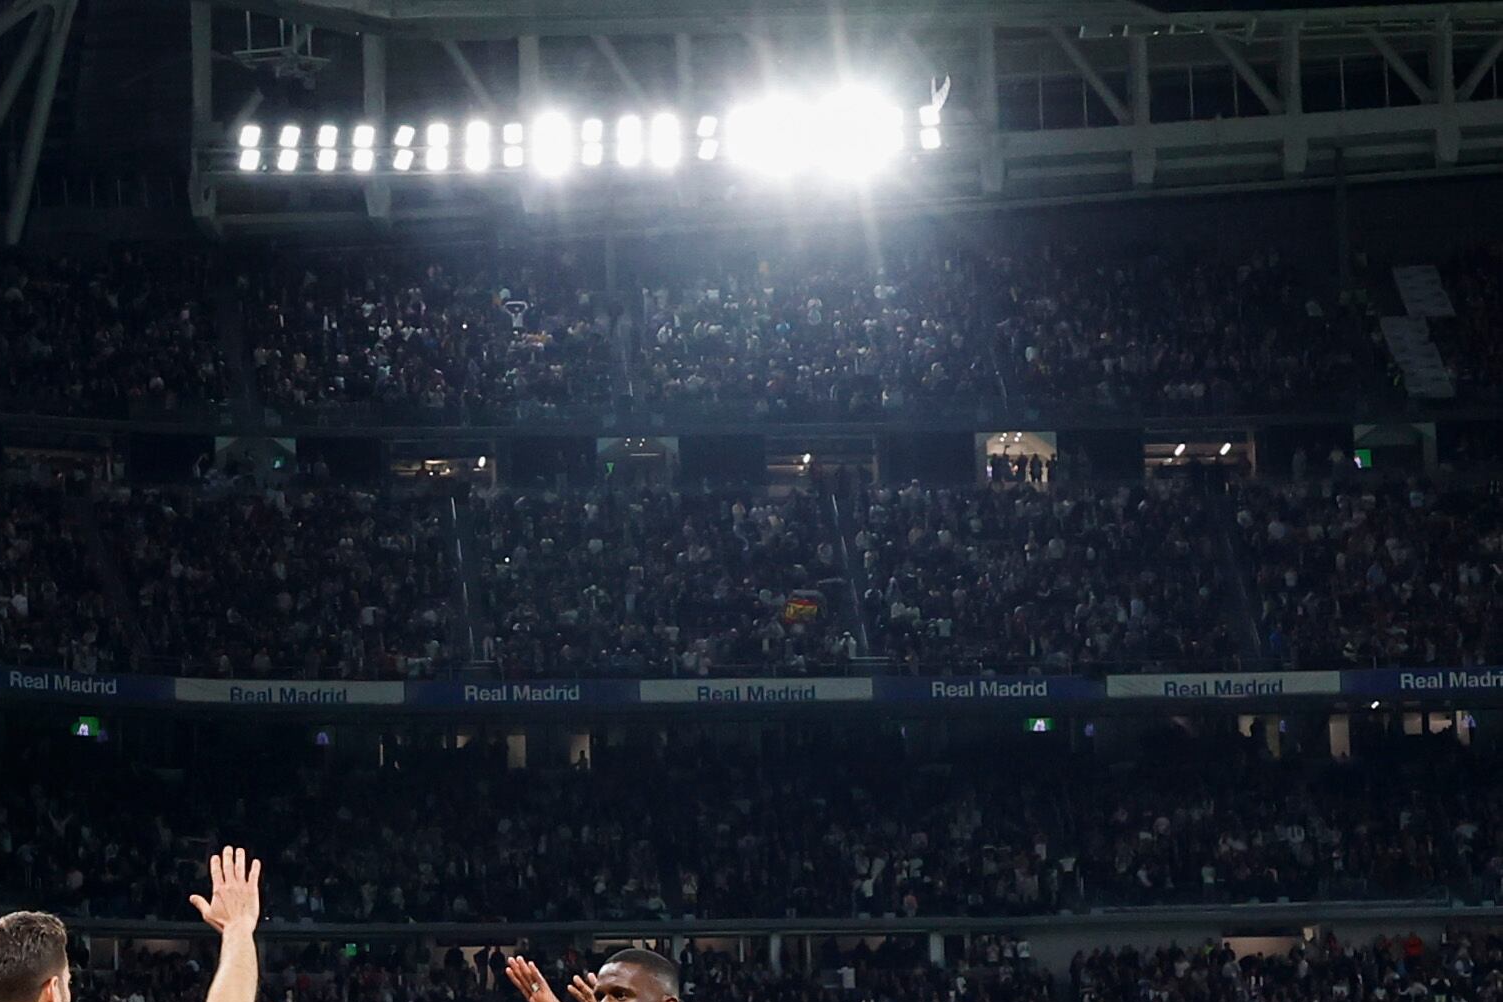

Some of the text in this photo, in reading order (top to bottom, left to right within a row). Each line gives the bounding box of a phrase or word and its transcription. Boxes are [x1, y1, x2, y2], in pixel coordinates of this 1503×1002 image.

[9, 671, 117, 694] Real Madrid
[1164, 679, 1283, 697] Real Madrid
[1400, 671, 1503, 689] Real Madri
[230, 687, 347, 703] Real Madrid
[464, 685, 580, 701] Real Madrid
[697, 685, 816, 701] Real Madrid
[931, 681, 1047, 697] Real Madrid
